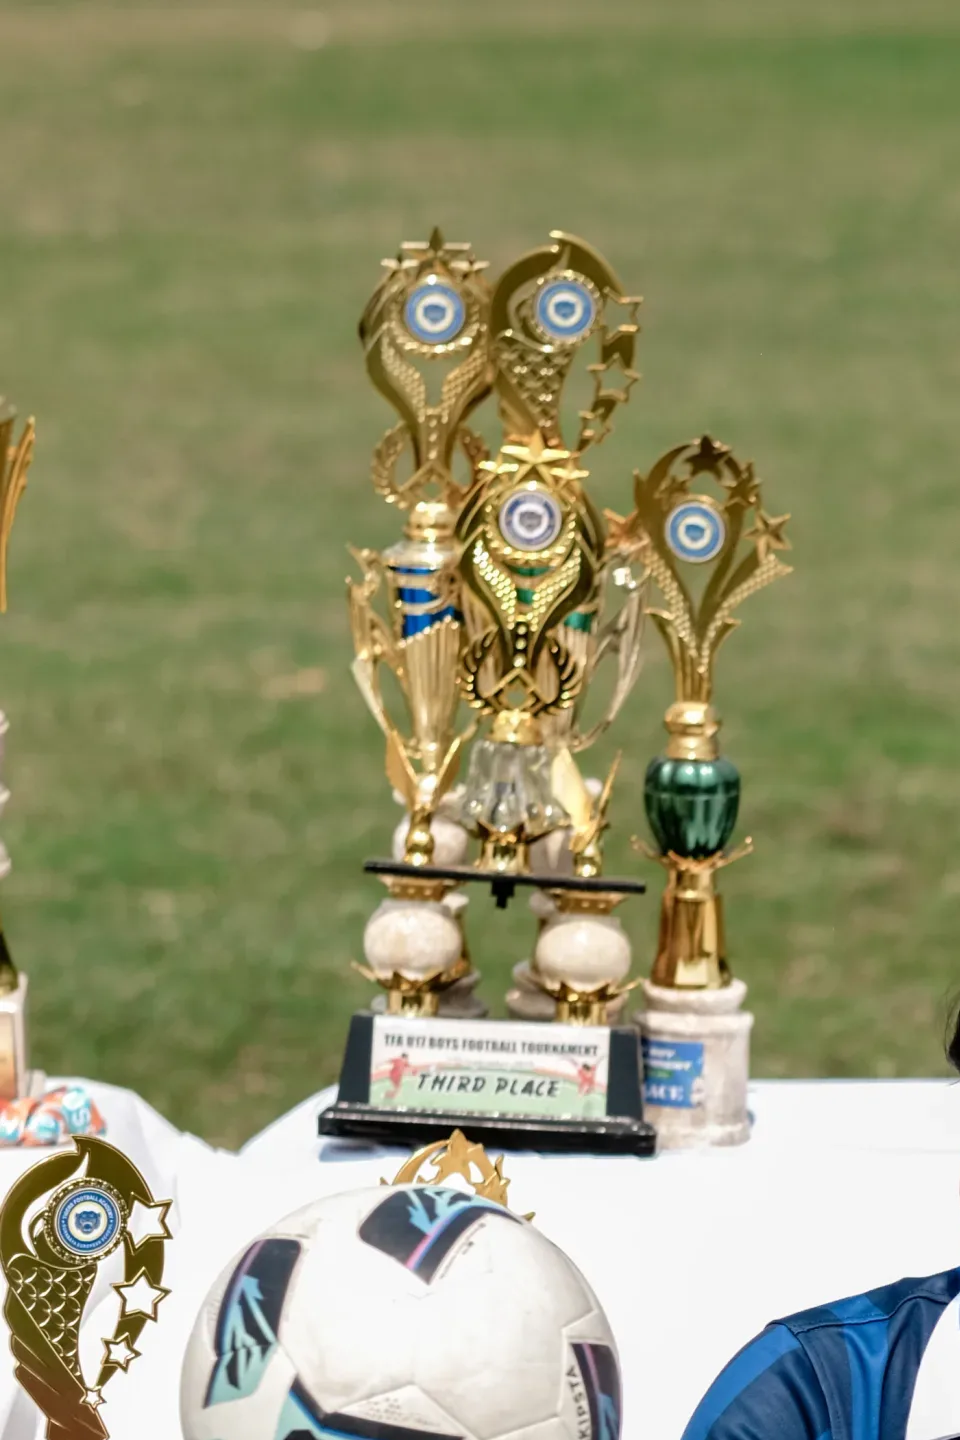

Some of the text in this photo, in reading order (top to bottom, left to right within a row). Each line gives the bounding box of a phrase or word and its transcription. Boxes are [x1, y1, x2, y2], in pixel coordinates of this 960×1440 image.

[429, 1037, 460, 1050] BOYS
[462, 1039, 517, 1053] FOOTBALL
[521, 1042, 599, 1056] TOURNAMENT
[417, 1073, 561, 1097] THIRD PLACE
[566, 1365, 590, 1440] KIPSTA
